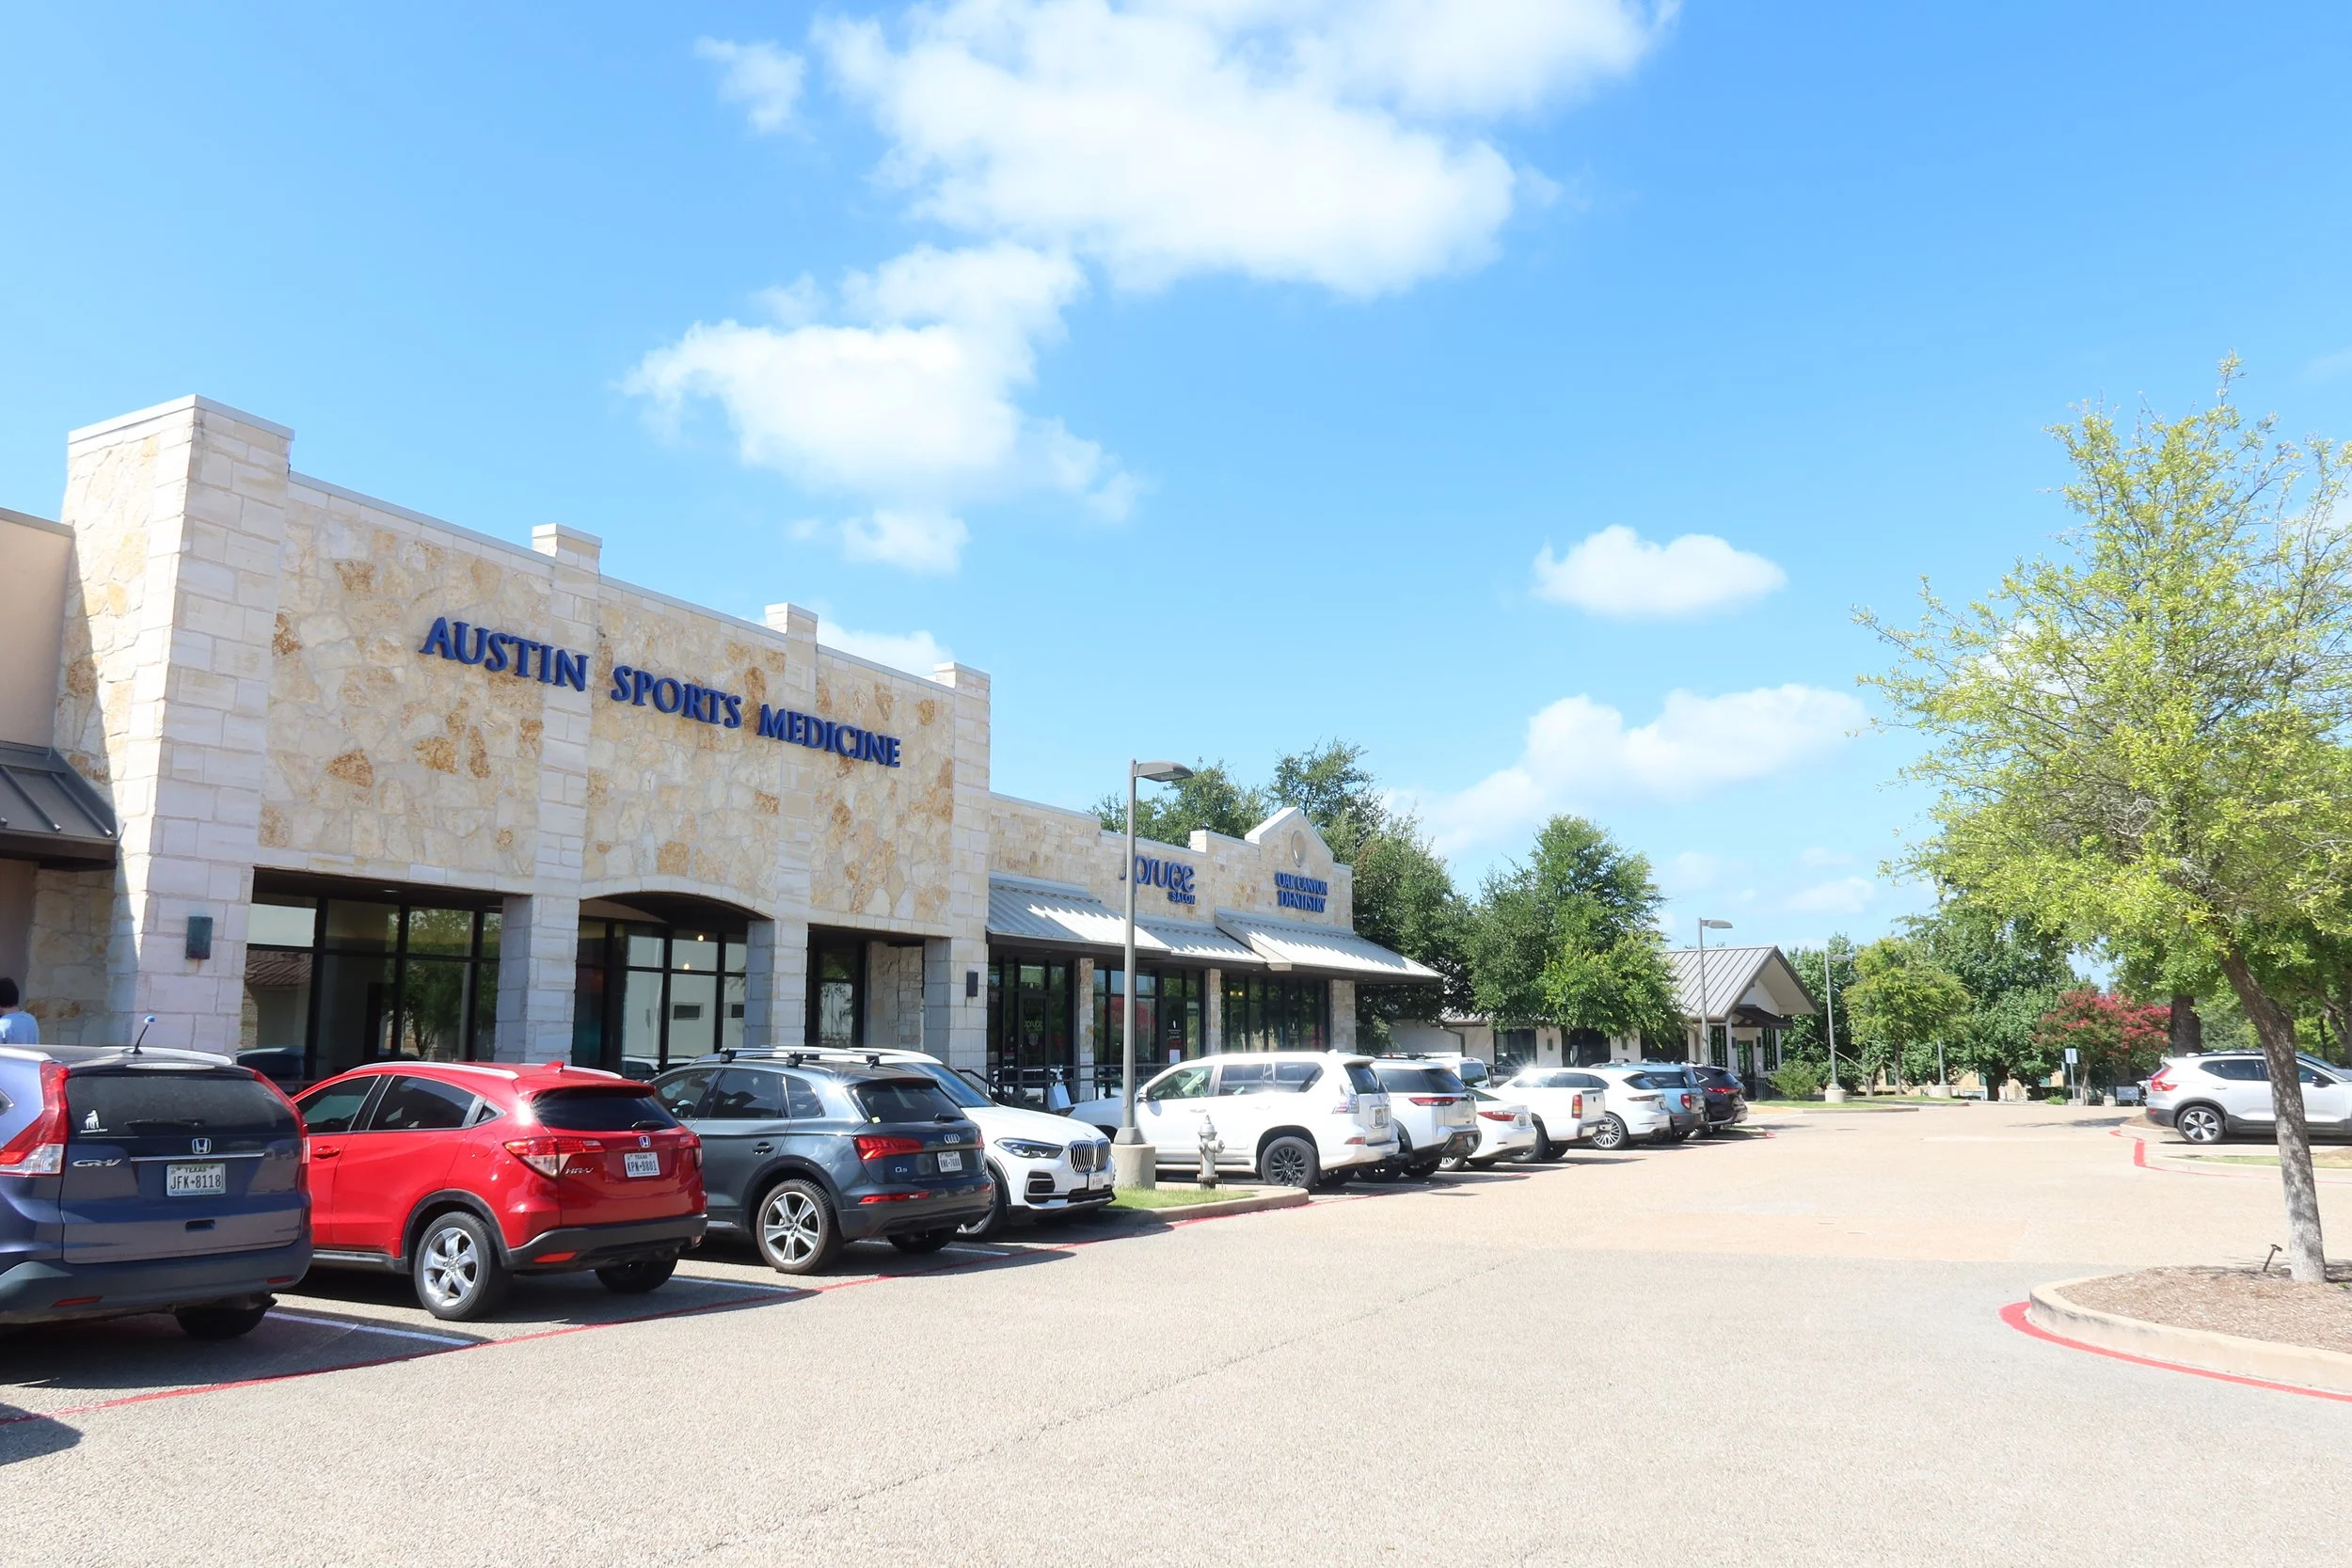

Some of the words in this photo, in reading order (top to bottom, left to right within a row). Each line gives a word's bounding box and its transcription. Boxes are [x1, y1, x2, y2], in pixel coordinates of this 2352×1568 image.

[419, 616, 589, 691] AUSTIN
[610, 665, 742, 728] SPORTS
[756, 704, 901, 768] MEDICINE
[1275, 872, 1295, 889] OAK
[1295, 876, 1327, 895] CANYON
[1168, 891, 1196, 904] SALON
[1278, 890, 1326, 913] DENTISTRY
